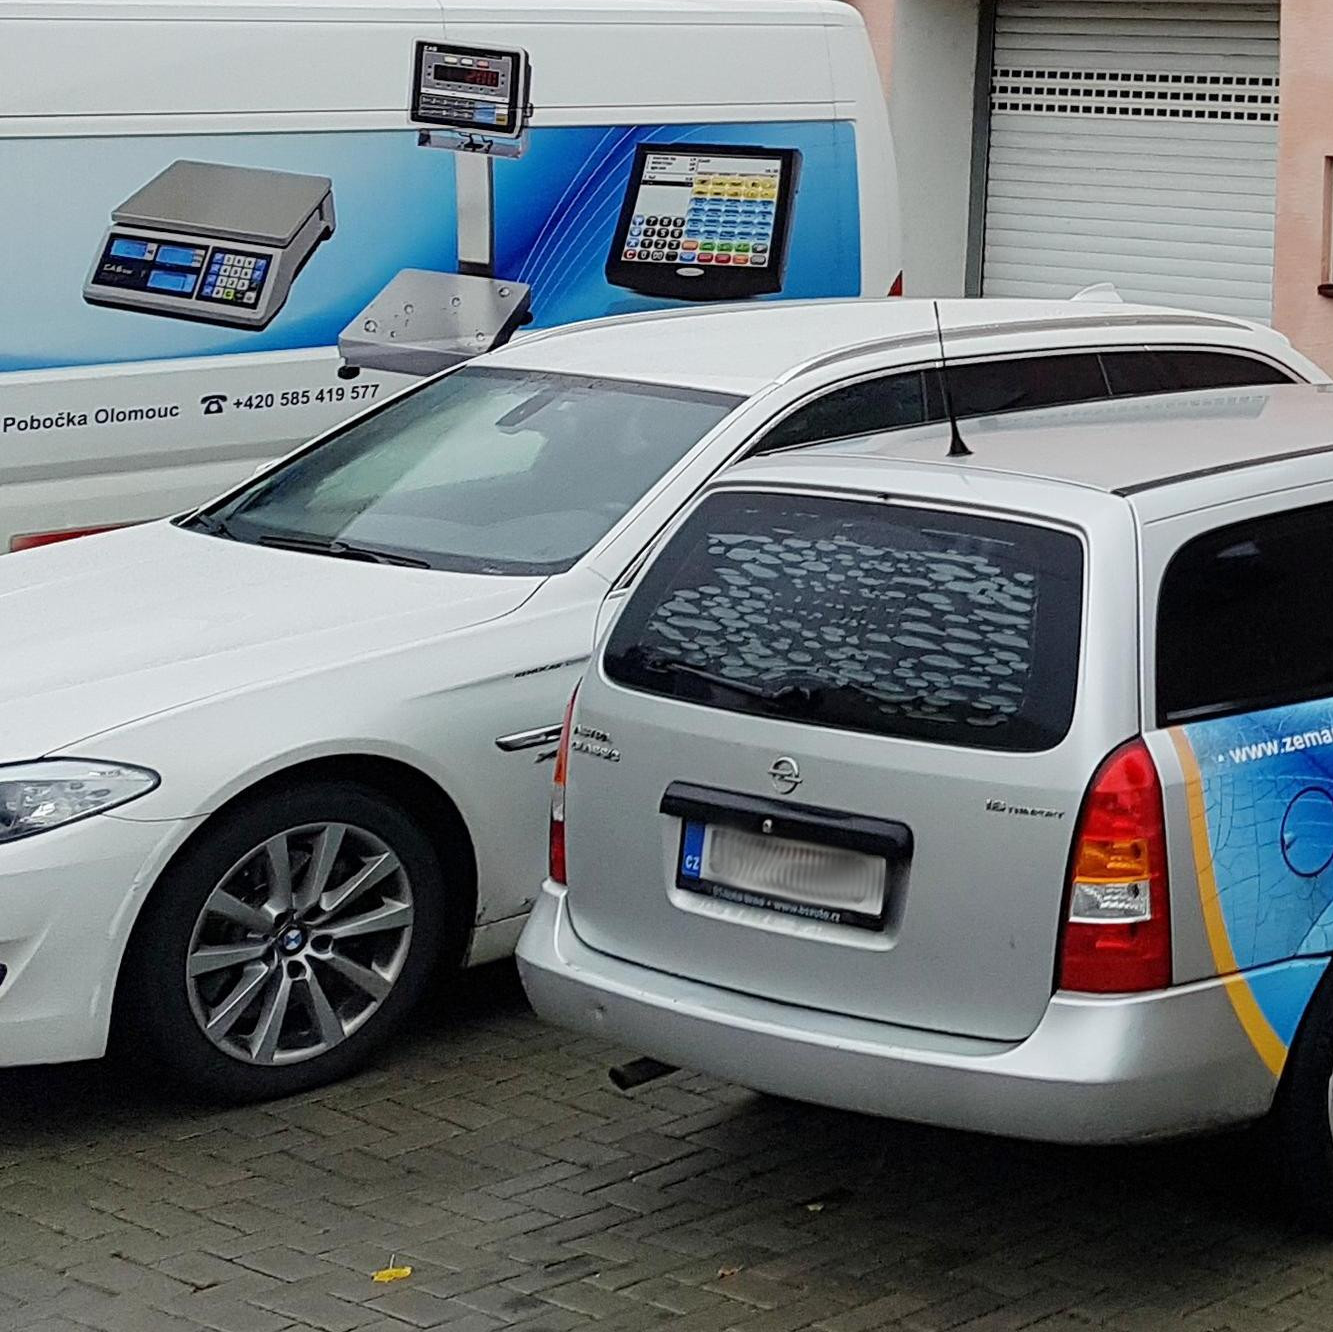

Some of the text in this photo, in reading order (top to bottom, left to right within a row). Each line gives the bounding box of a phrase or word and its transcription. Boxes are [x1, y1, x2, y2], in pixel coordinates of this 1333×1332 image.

[3, 384, 380, 432] Pobočka Olomouc +420 585 419 577
[685, 855, 700, 869] CZ
